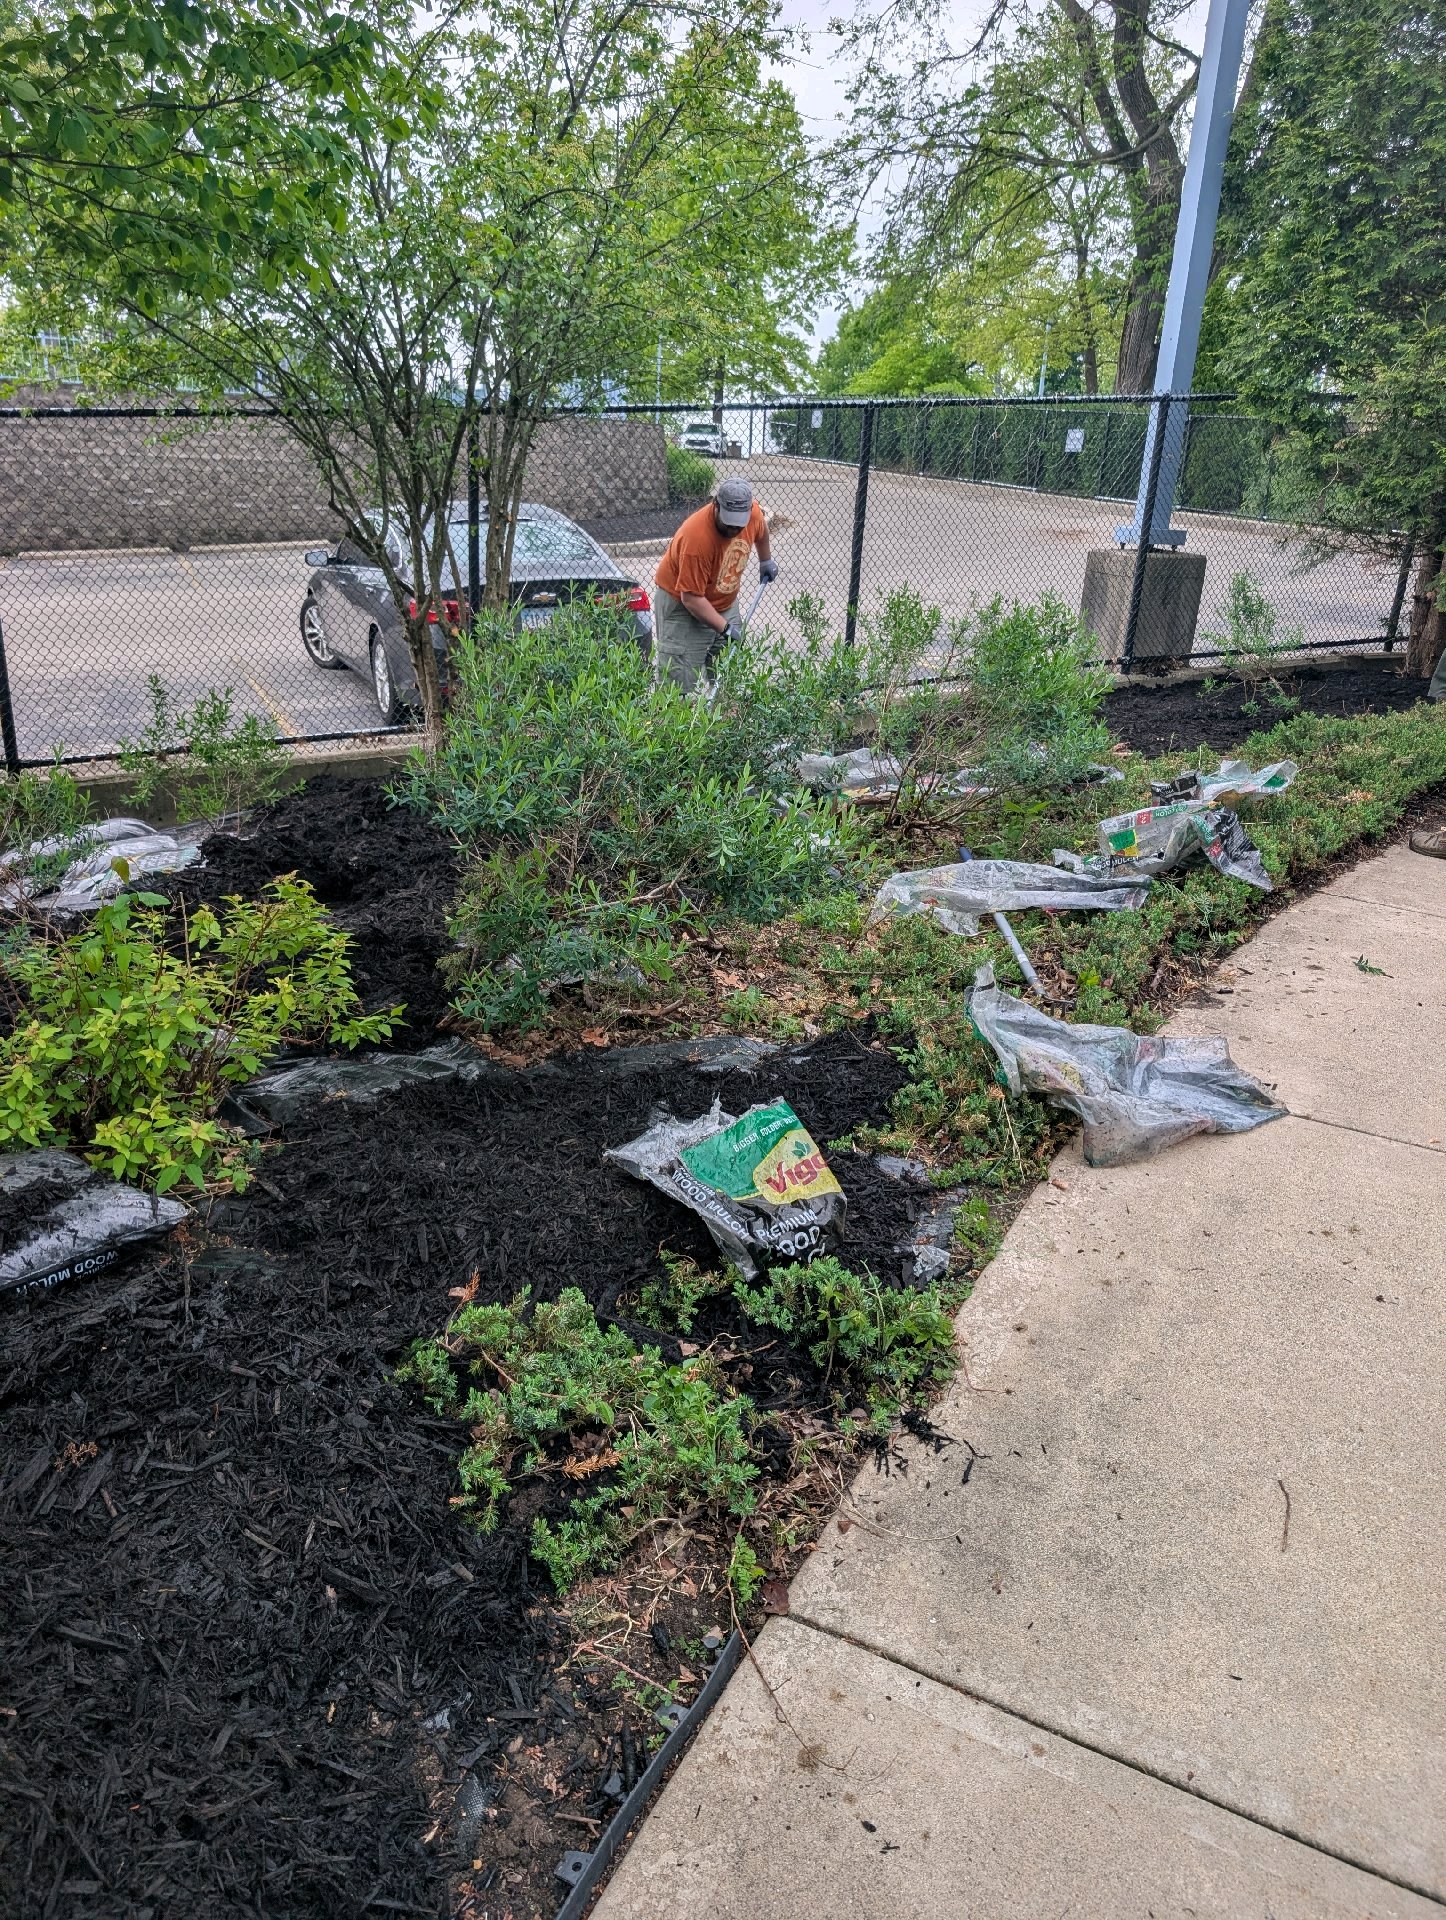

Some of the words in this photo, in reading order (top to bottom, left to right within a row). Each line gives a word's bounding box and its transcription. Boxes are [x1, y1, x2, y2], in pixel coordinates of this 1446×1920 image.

[671, 1169, 707, 1202] WOOD
[705, 1200, 750, 1240] MULCH
[775, 1225, 820, 1256] OOD
[74, 1251, 119, 1274] WOOD
